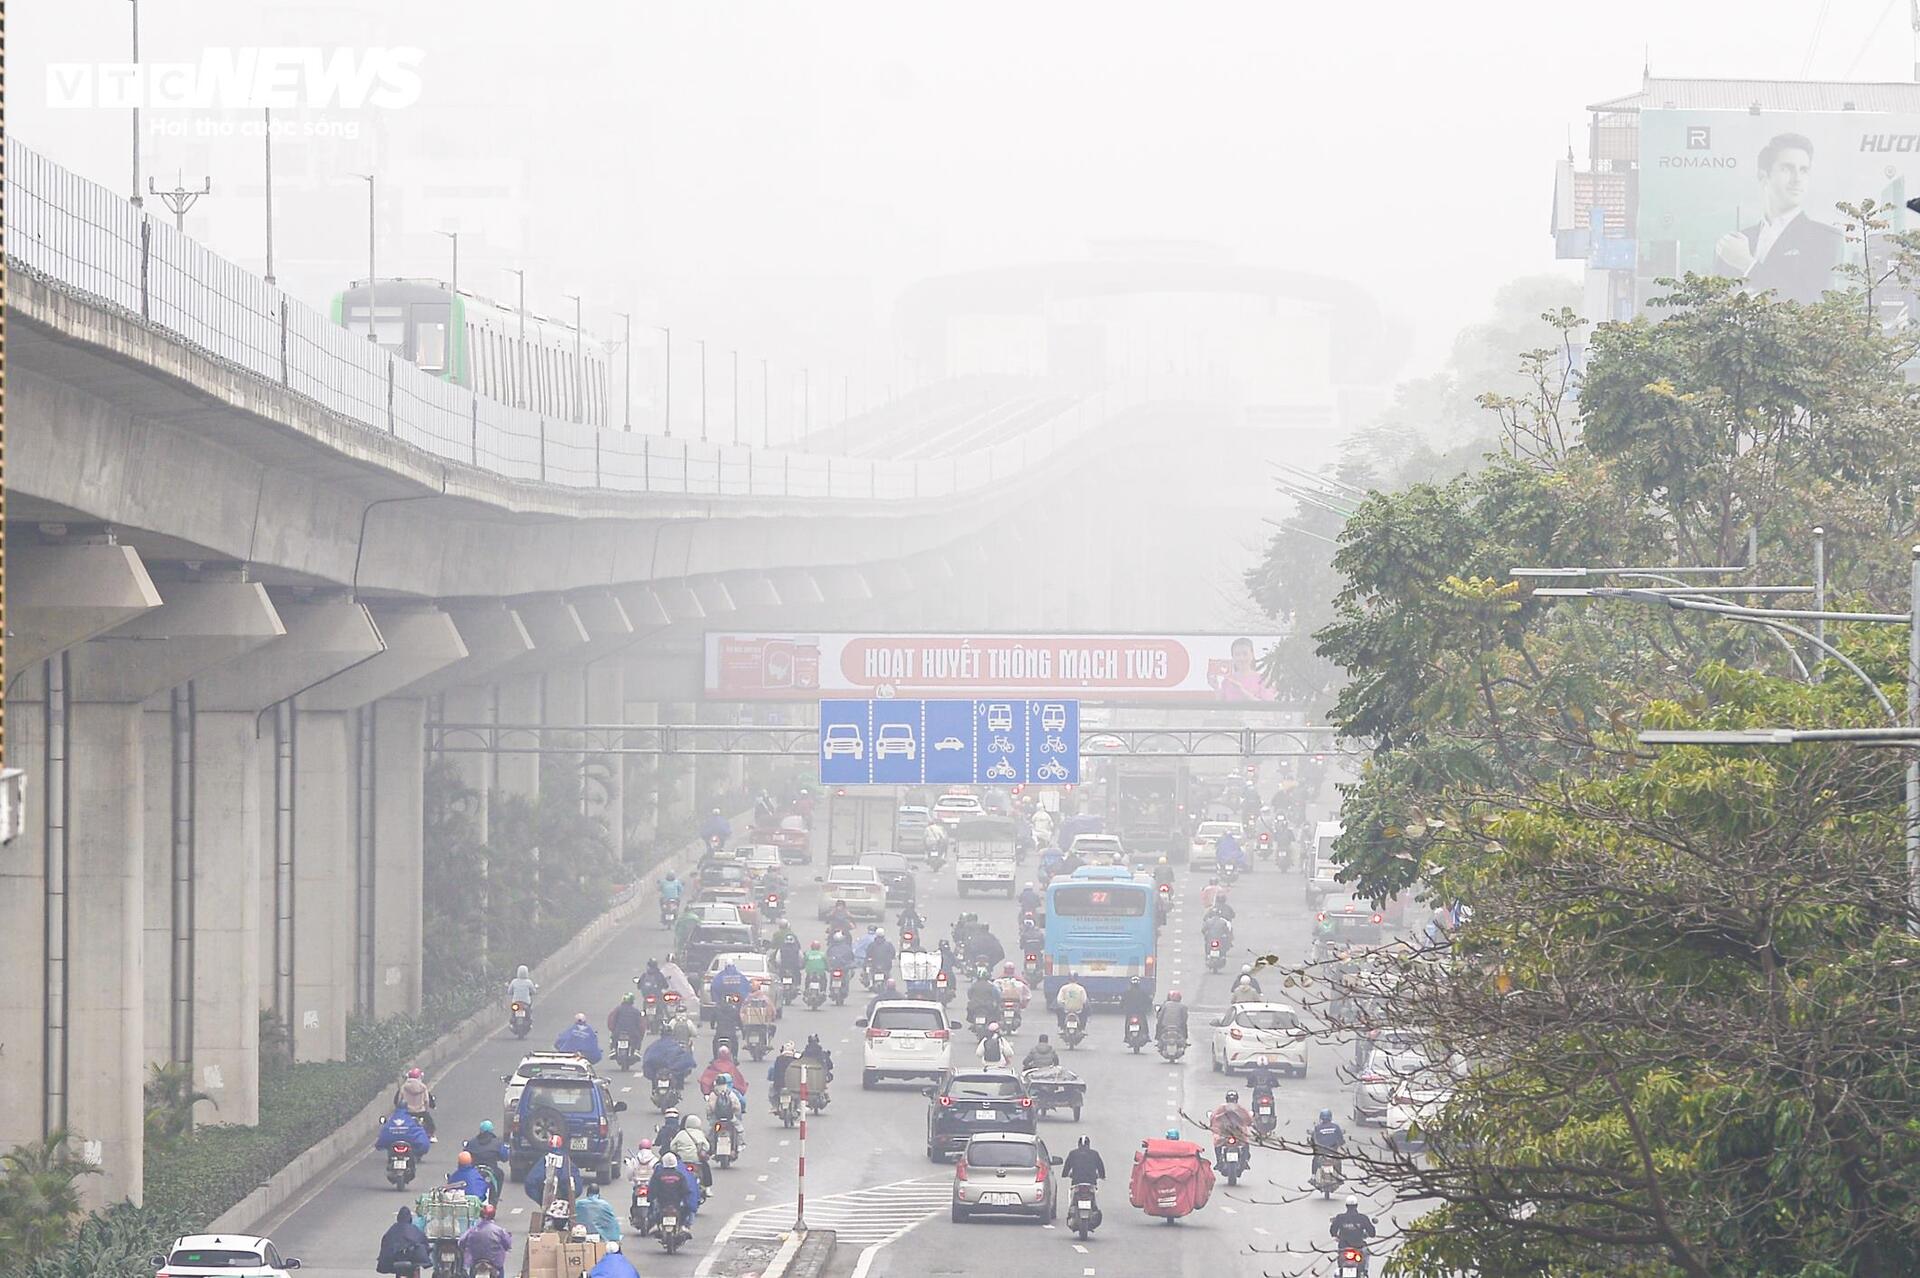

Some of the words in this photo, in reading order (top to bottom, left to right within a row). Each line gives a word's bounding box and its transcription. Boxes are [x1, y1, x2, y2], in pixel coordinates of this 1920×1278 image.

[1658, 156, 1737, 169] ROMANO
[864, 648, 915, 685] HOẠT
[921, 639, 982, 679] HUYẾT
[987, 644, 1052, 679] THÔNG
[1058, 648, 1117, 686] MẠCH
[1124, 648, 1168, 679] TW3
[1092, 892, 1107, 902] 27
